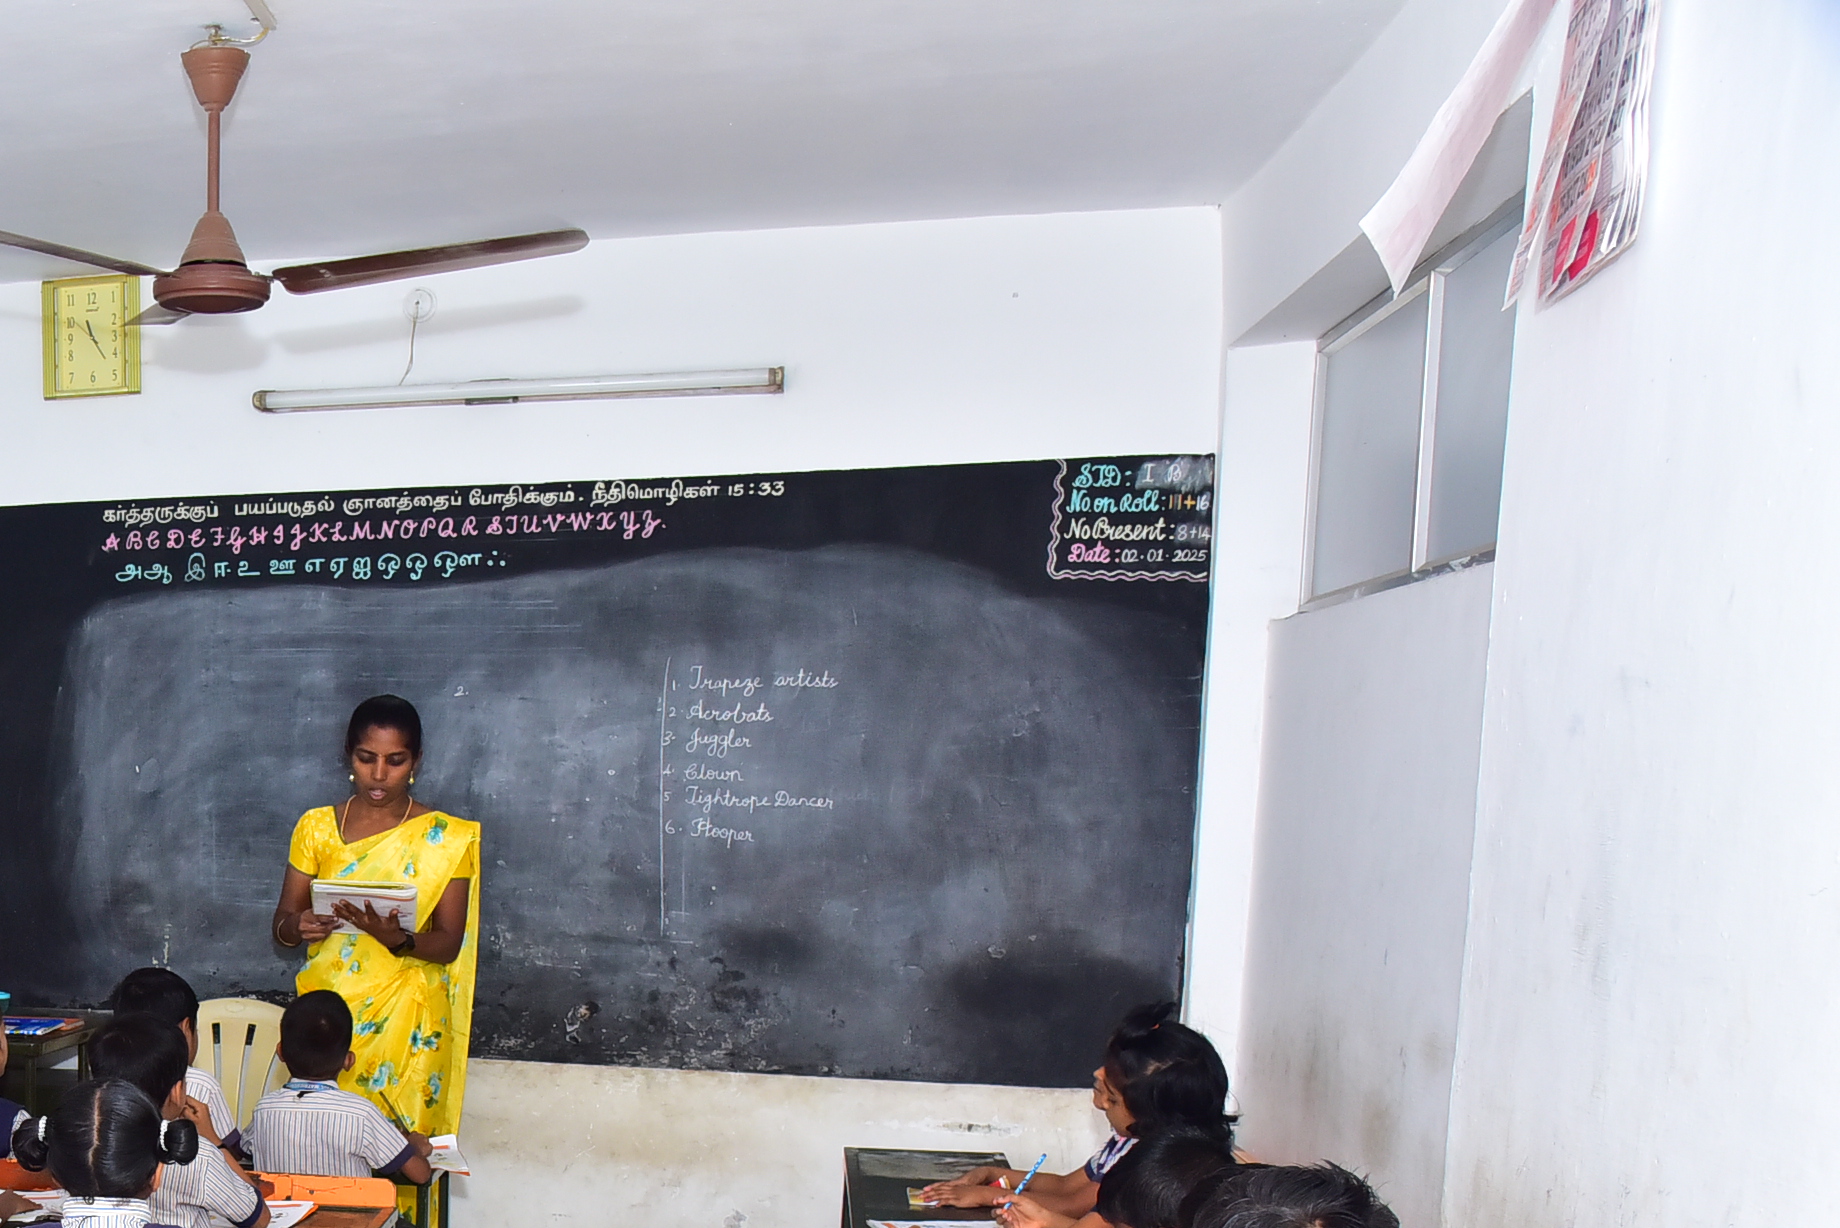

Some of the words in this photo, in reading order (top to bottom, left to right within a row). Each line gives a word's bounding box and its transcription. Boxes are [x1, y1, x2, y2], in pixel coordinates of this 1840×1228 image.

[67, 294, 75, 307] 11
[87, 292, 97, 306] 12
[111, 291, 116, 303] 1
[67, 316, 76, 329] 10
[111, 313, 117, 326] 2
[68, 333, 74, 346] 9
[111, 330, 118, 342] 3
[68, 350, 74, 362] 8
[111, 347, 118, 358] 4
[68, 372, 75, 384] 7
[90, 371, 96, 383] 6
[111, 369, 118, 381] 5
[1141, 463, 1156, 483] I
[102, 501, 219, 528] கர்த்தருக்குப்
[234, 497, 335, 519] பயப்படுதல்
[343, 490, 462, 516] ஞானத்தைப்
[590, 479, 721, 507] நீதிமொழிகள்
[1093, 496, 1118, 513] on
[1064, 517, 1091, 541] No
[688, 665, 764, 698] Trapeze
[773, 668, 839, 689] artists
[685, 699, 774, 723] Acrobats
[685, 727, 753, 759] Juggler
[684, 763, 744, 782] Clown
[685, 785, 772, 813] Tightrope
[774, 790, 834, 811] Dancer
